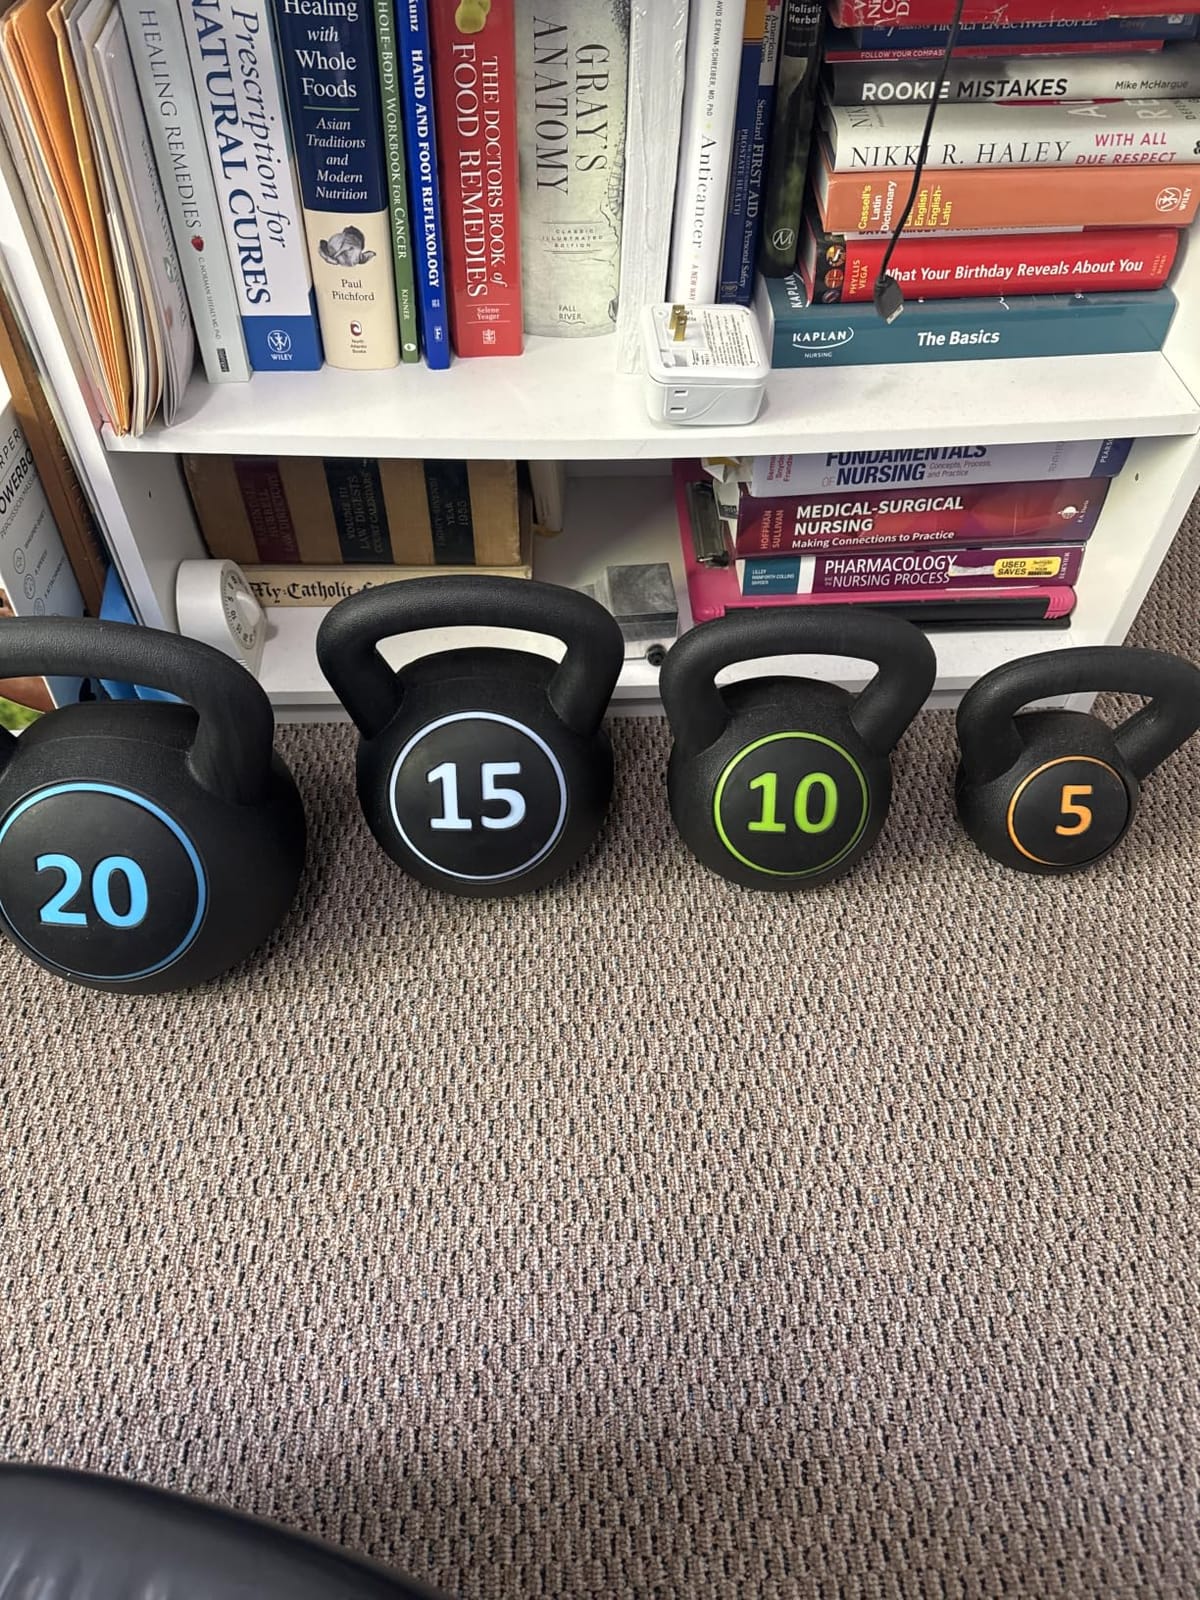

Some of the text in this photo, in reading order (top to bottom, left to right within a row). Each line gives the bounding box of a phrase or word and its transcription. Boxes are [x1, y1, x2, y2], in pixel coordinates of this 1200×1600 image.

[284, 0, 359, 22] Healing
[788, 3, 822, 14] Holistic
[788, 13, 821, 25] Herbal
[307, 26, 340, 42] with
[767, 15, 779, 63] American
[294, 49, 357, 70] Whole
[300, 77, 357, 97] Foods
[861, 78, 1068, 101] ROOKIE MISTAKES
[1115, 79, 1189, 91] Mike McHargue
[532, 15, 569, 196] ANATOMY
[574, 43, 611, 173] GRAY'S
[139, 10, 178, 117] HEALING
[165, 126, 201, 228] REMEDIES
[231, 6, 290, 248] Prescription for
[315, 118, 351, 130] Asian
[306, 134, 367, 148] Traditions
[386, 97, 401, 182] WORKBOOK
[1094, 132, 1167, 147] WITH ALL
[326, 154, 349, 165] and
[734, 128, 749, 177] PROSTATE
[849, 140, 1071, 168] NIKKI R. HALEY
[1075, 152, 1177, 165] DUE RESPECT
[317, 169, 363, 183] Modern
[411, 50, 439, 288] HAND AND FOOT REFLEXOLOGY
[452, 41, 488, 297] FOOD REMEDIES
[482, 55, 508, 287] THE DOCTORS BOOK of
[749, 143, 765, 188] FIRST
[315, 186, 368, 200] Nutrition
[392, 184, 402, 205] FOR
[691, 133, 717, 249] Anticancer
[732, 178, 743, 216] HEALTH
[746, 188, 760, 218] AID
[857, 184, 872, 230] Cassell's
[870, 194, 883, 221] Latin
[880, 180, 897, 232] Dictionary
[914, 190, 929, 226] English
[939, 201, 953, 226] Latin
[394, 207, 407, 260] CANCER
[745, 220, 753, 228] &
[229, 188, 271, 304] CURES
[743, 229, 754, 261] Personal
[739, 261, 750, 289] Safety
[849, 259, 861, 295] PHYLLIS
[858, 265, 869, 289] VEGA
[920, 266, 951, 281] Your
[954, 262, 1013, 281] Birthday
[1016, 261, 1069, 277] Reveals
[1071, 259, 1115, 275] About
[1118, 257, 1144, 273] You
[341, 279, 362, 288] Paul
[332, 290, 375, 302] Pitchford
[401, 288, 410, 320] KENNER
[558, 304, 577, 312] FALL
[792, 330, 847, 343] KAPLAN
[917, 329, 1000, 347] The Basics
[270, 353, 294, 361] WILEY
[804, 351, 833, 359] NURSING
[826, 445, 988, 467] FUNDAMENTALS
[929, 460, 963, 470] Concepts,
[836, 463, 927, 487] NURSING
[927, 468, 969, 478] and Practice
[796, 496, 964, 519] MEDICAL-SURGICAL
[760, 510, 773, 550] HOFFMAN
[772, 509, 785, 549] SULLIVAN
[794, 518, 874, 536] NURSING
[791, 530, 955, 549] Making Connections to Practice
[824, 555, 958, 575] PHARMACOLOGY
[998, 568, 1027, 576] SAVES
[1001, 560, 1027, 569] USED
[832, 571, 951, 588] NURSING PROCESS
[425, 761, 528, 831] 15
[746, 771, 839, 835] 10
[1054, 784, 1093, 837] 5
[35, 853, 150, 929] 20
